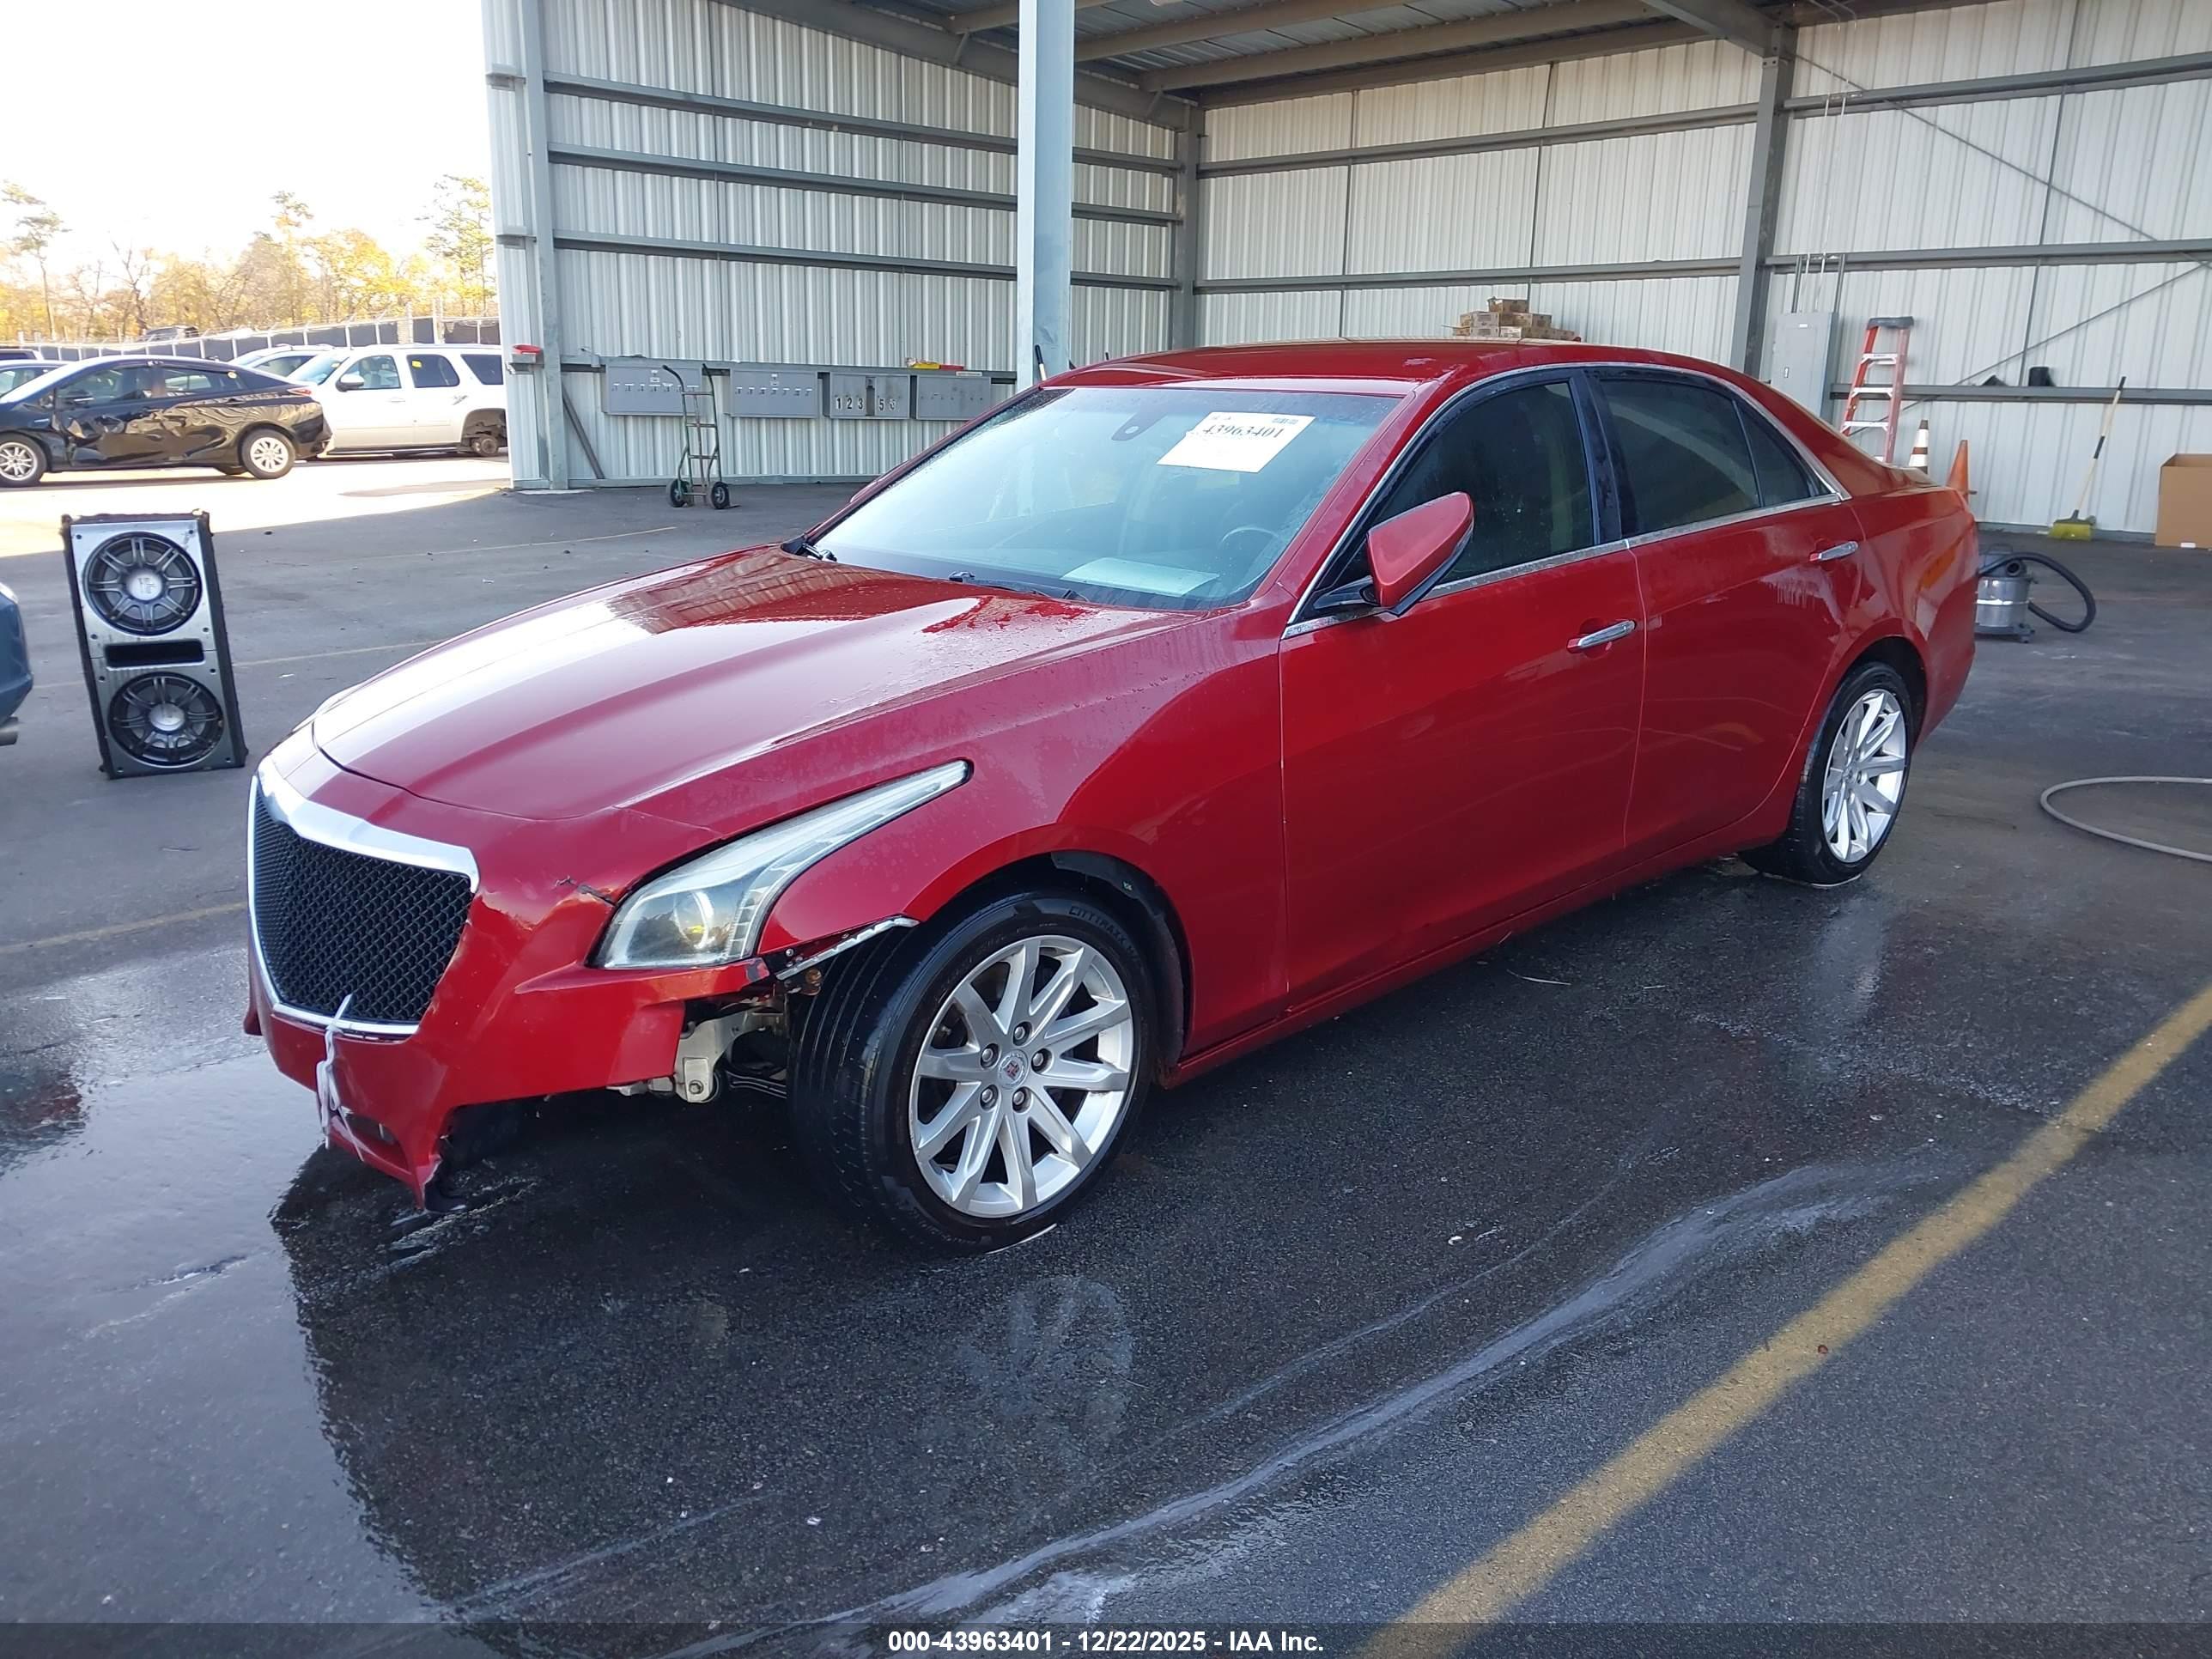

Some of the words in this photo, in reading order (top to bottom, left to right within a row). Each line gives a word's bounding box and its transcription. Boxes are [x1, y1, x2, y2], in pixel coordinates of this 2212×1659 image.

[836, 398, 842, 410] 1
[847, 398, 853, 410] 2
[858, 398, 864, 410] 3
[878, 398, 884, 410] 5
[1202, 424, 1285, 438] 43963401
